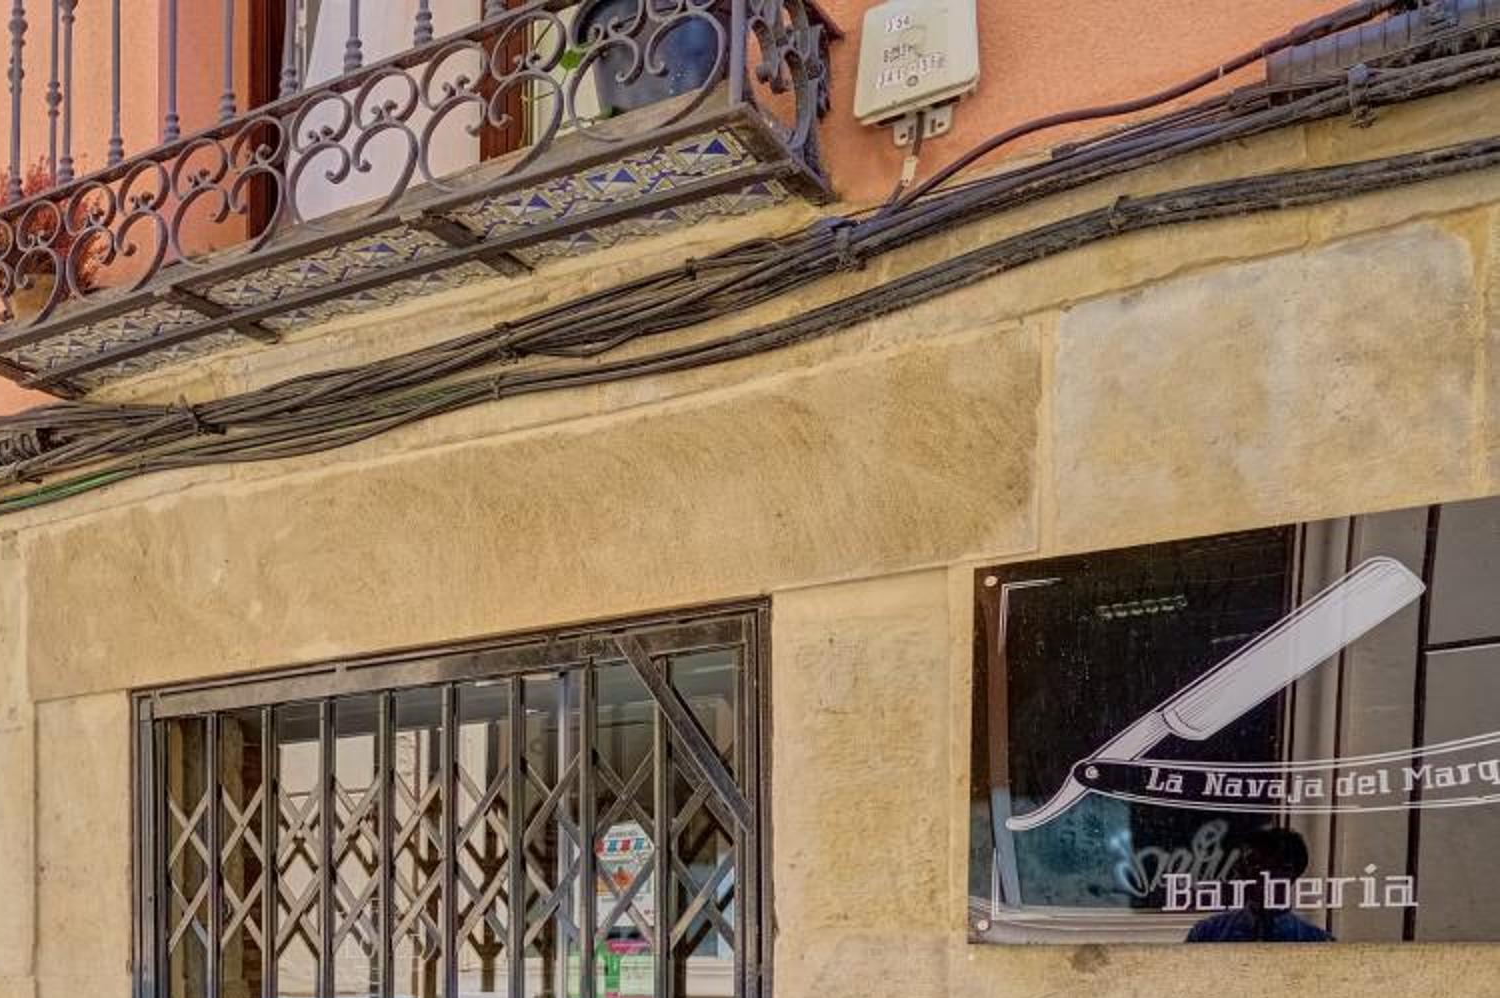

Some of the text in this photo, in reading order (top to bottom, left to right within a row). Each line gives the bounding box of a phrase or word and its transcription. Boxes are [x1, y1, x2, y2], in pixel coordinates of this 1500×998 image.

[1146, 760, 1500, 804] La Navaja del Marq
[1160, 863, 1419, 911] Barbería
